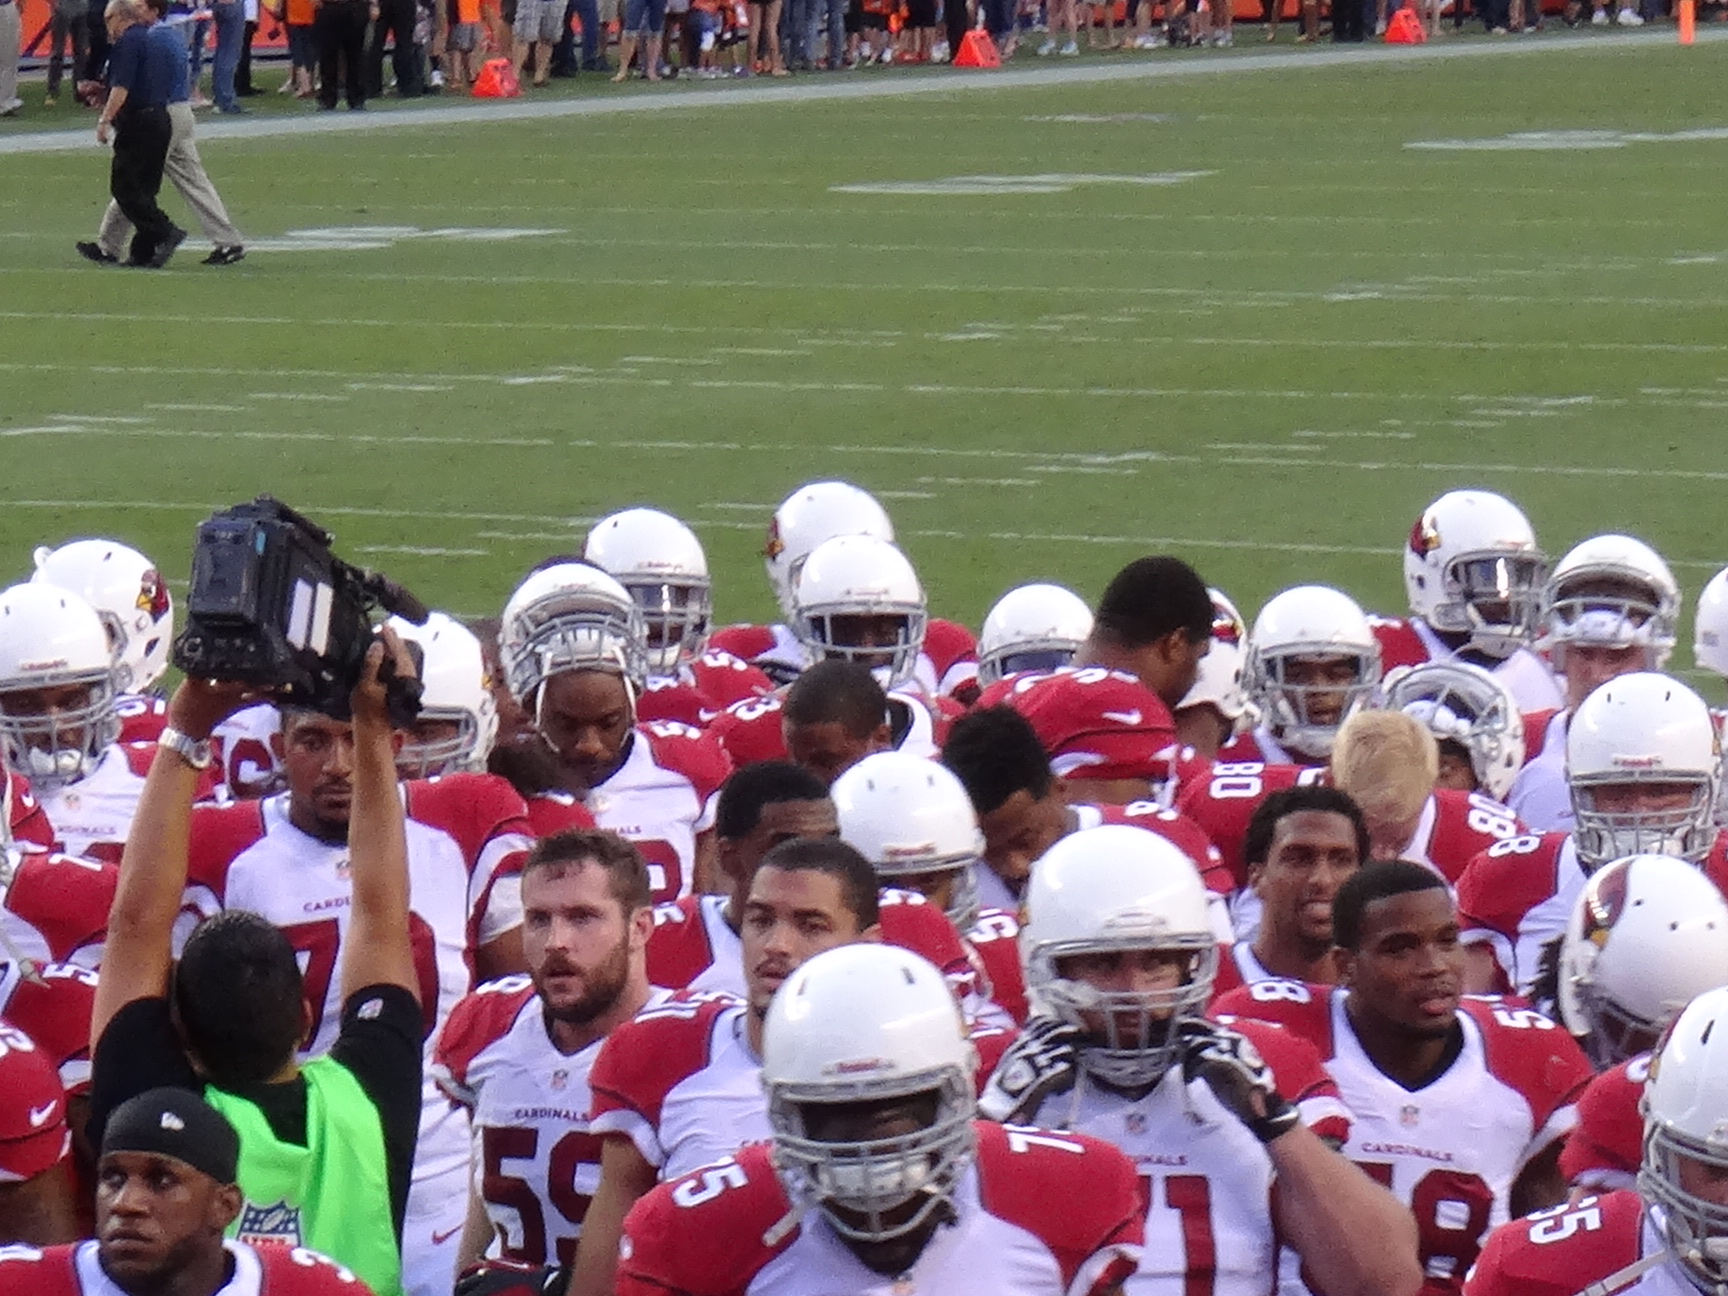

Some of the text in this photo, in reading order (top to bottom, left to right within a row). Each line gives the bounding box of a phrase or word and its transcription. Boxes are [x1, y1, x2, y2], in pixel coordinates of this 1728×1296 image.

[1208, 760, 1265, 800] 80
[1467, 792, 1518, 838] 8
[302, 897, 352, 912] CARDI
[672, 1154, 749, 1209] 5
